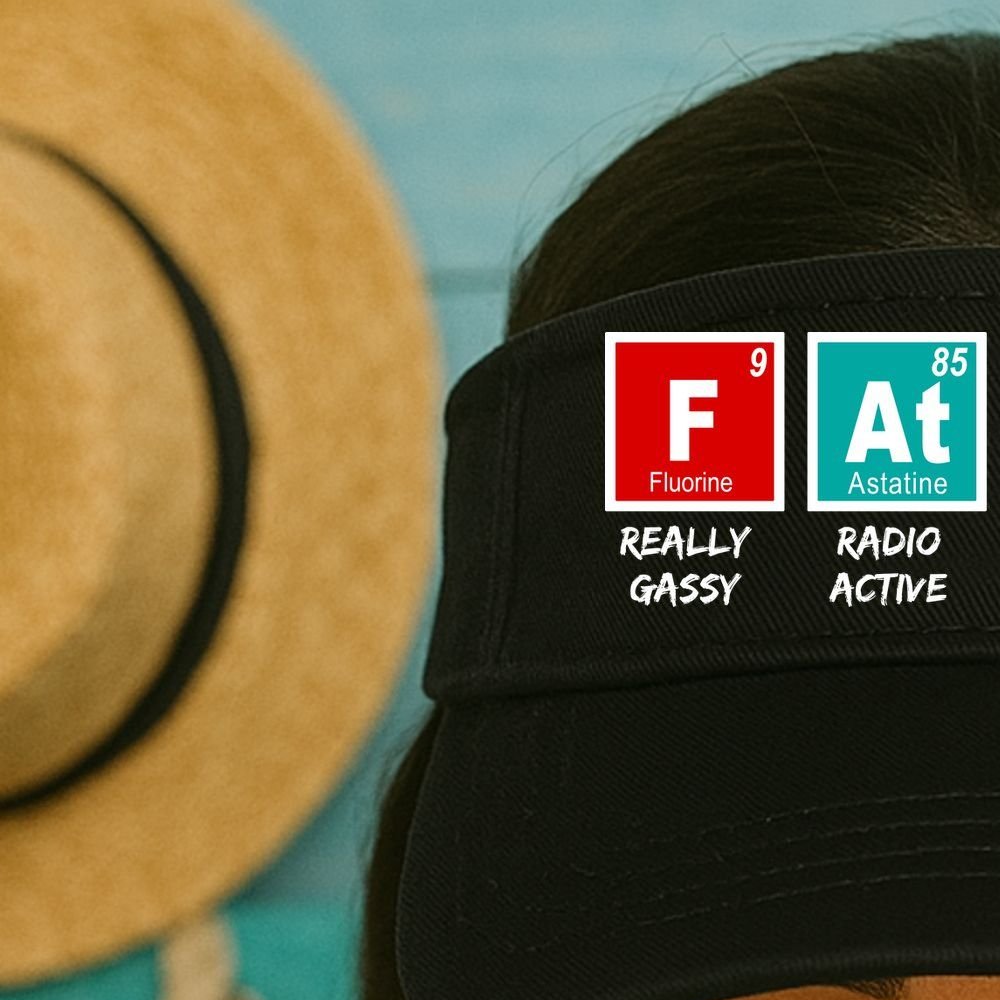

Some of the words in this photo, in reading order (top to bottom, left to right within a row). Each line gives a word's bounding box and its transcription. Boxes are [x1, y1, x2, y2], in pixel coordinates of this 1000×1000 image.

[750, 347, 768, 378] 9
[931, 347, 969, 377] 85
[669, 379, 718, 462] F
[845, 381, 951, 464] At
[649, 471, 733, 493] Fluorine
[848, 471, 948, 495] Astatine
[619, 525, 753, 560] REALLY
[836, 525, 941, 560] RADIO
[629, 572, 742, 608] GASSY
[828, 571, 948, 608] ACTIVE
